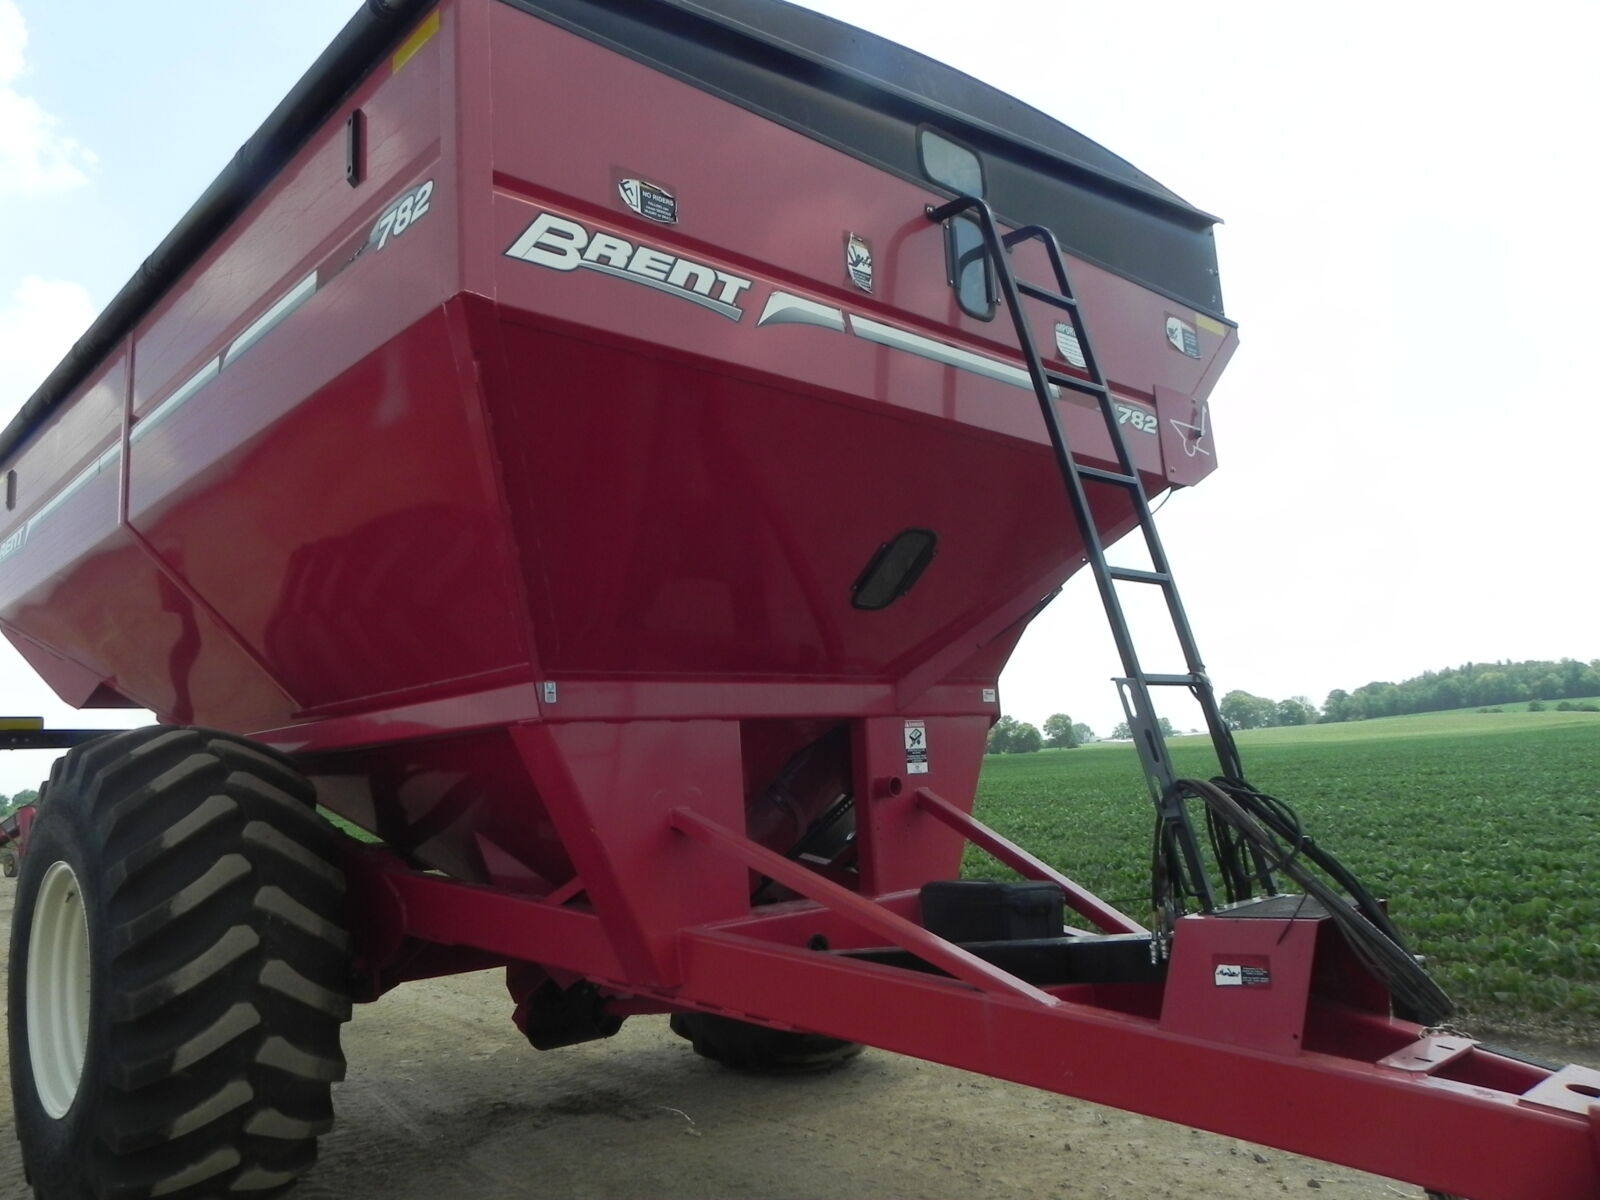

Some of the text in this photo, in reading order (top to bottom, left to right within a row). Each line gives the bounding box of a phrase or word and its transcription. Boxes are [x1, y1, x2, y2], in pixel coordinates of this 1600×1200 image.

[377, 179, 434, 251] 782
[642, 190, 674, 206] NO RIDERS
[504, 212, 752, 306] BRENT
[1117, 405, 1158, 435] 782
